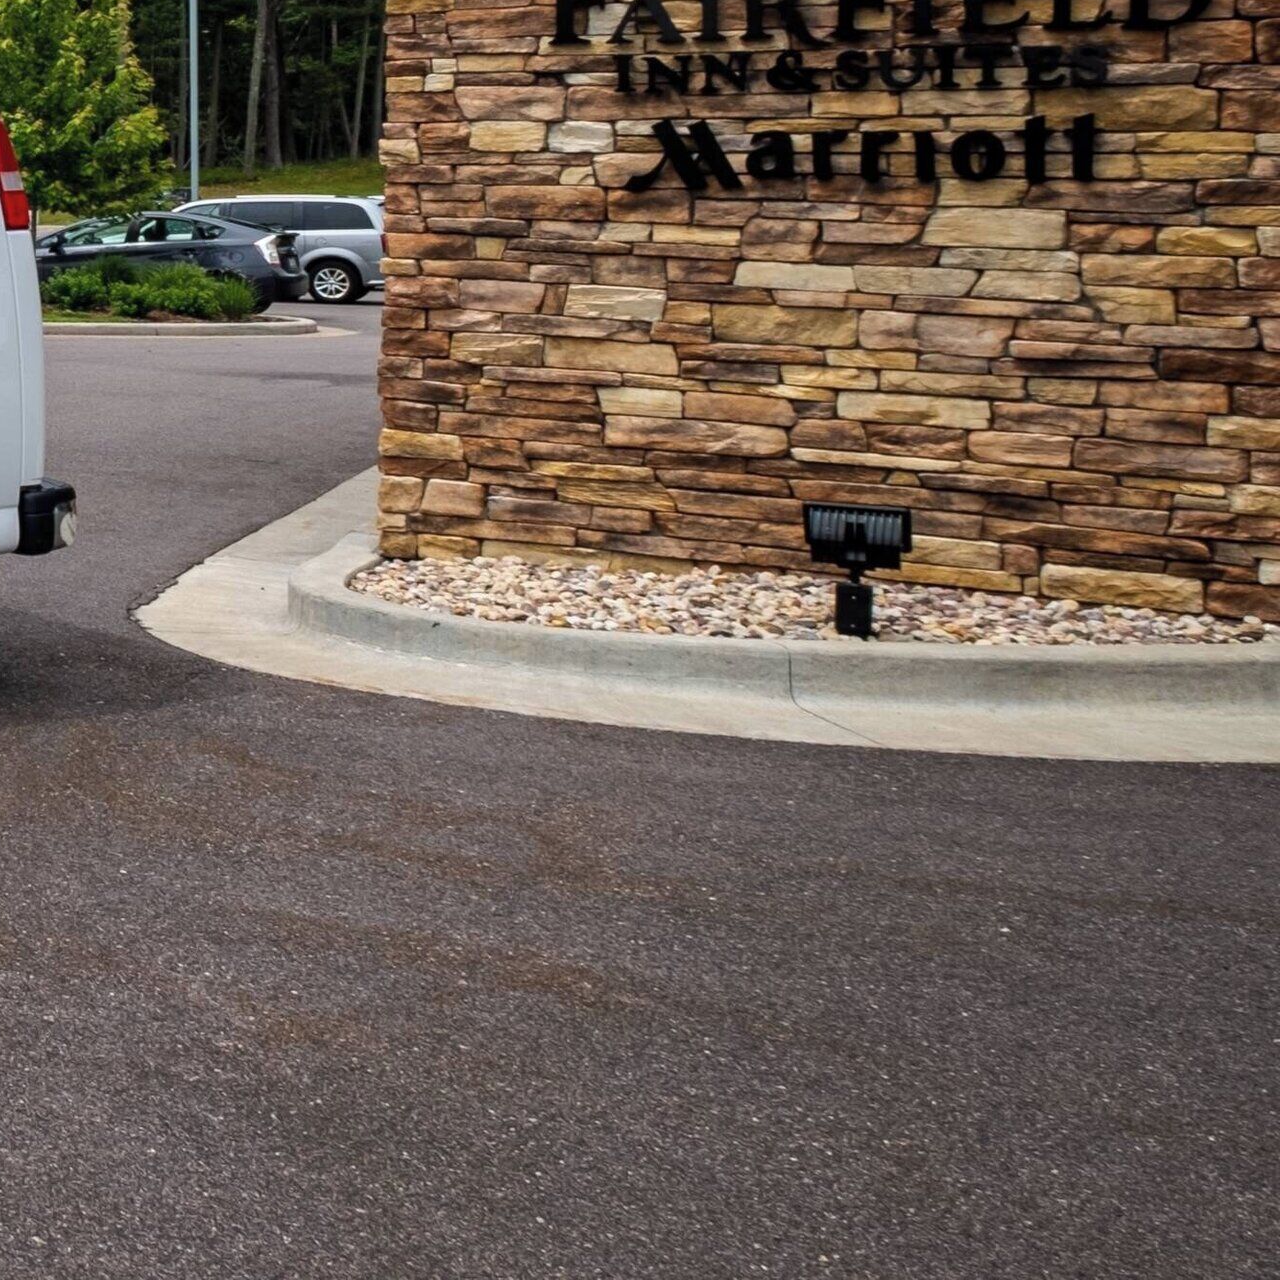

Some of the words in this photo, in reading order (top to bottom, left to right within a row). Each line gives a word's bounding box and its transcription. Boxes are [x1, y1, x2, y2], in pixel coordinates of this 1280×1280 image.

[613, 51, 752, 97] INN
[766, 49, 821, 93] &
[834, 43, 1110, 93] SUITES
[624, 113, 1100, 192] Marriott
